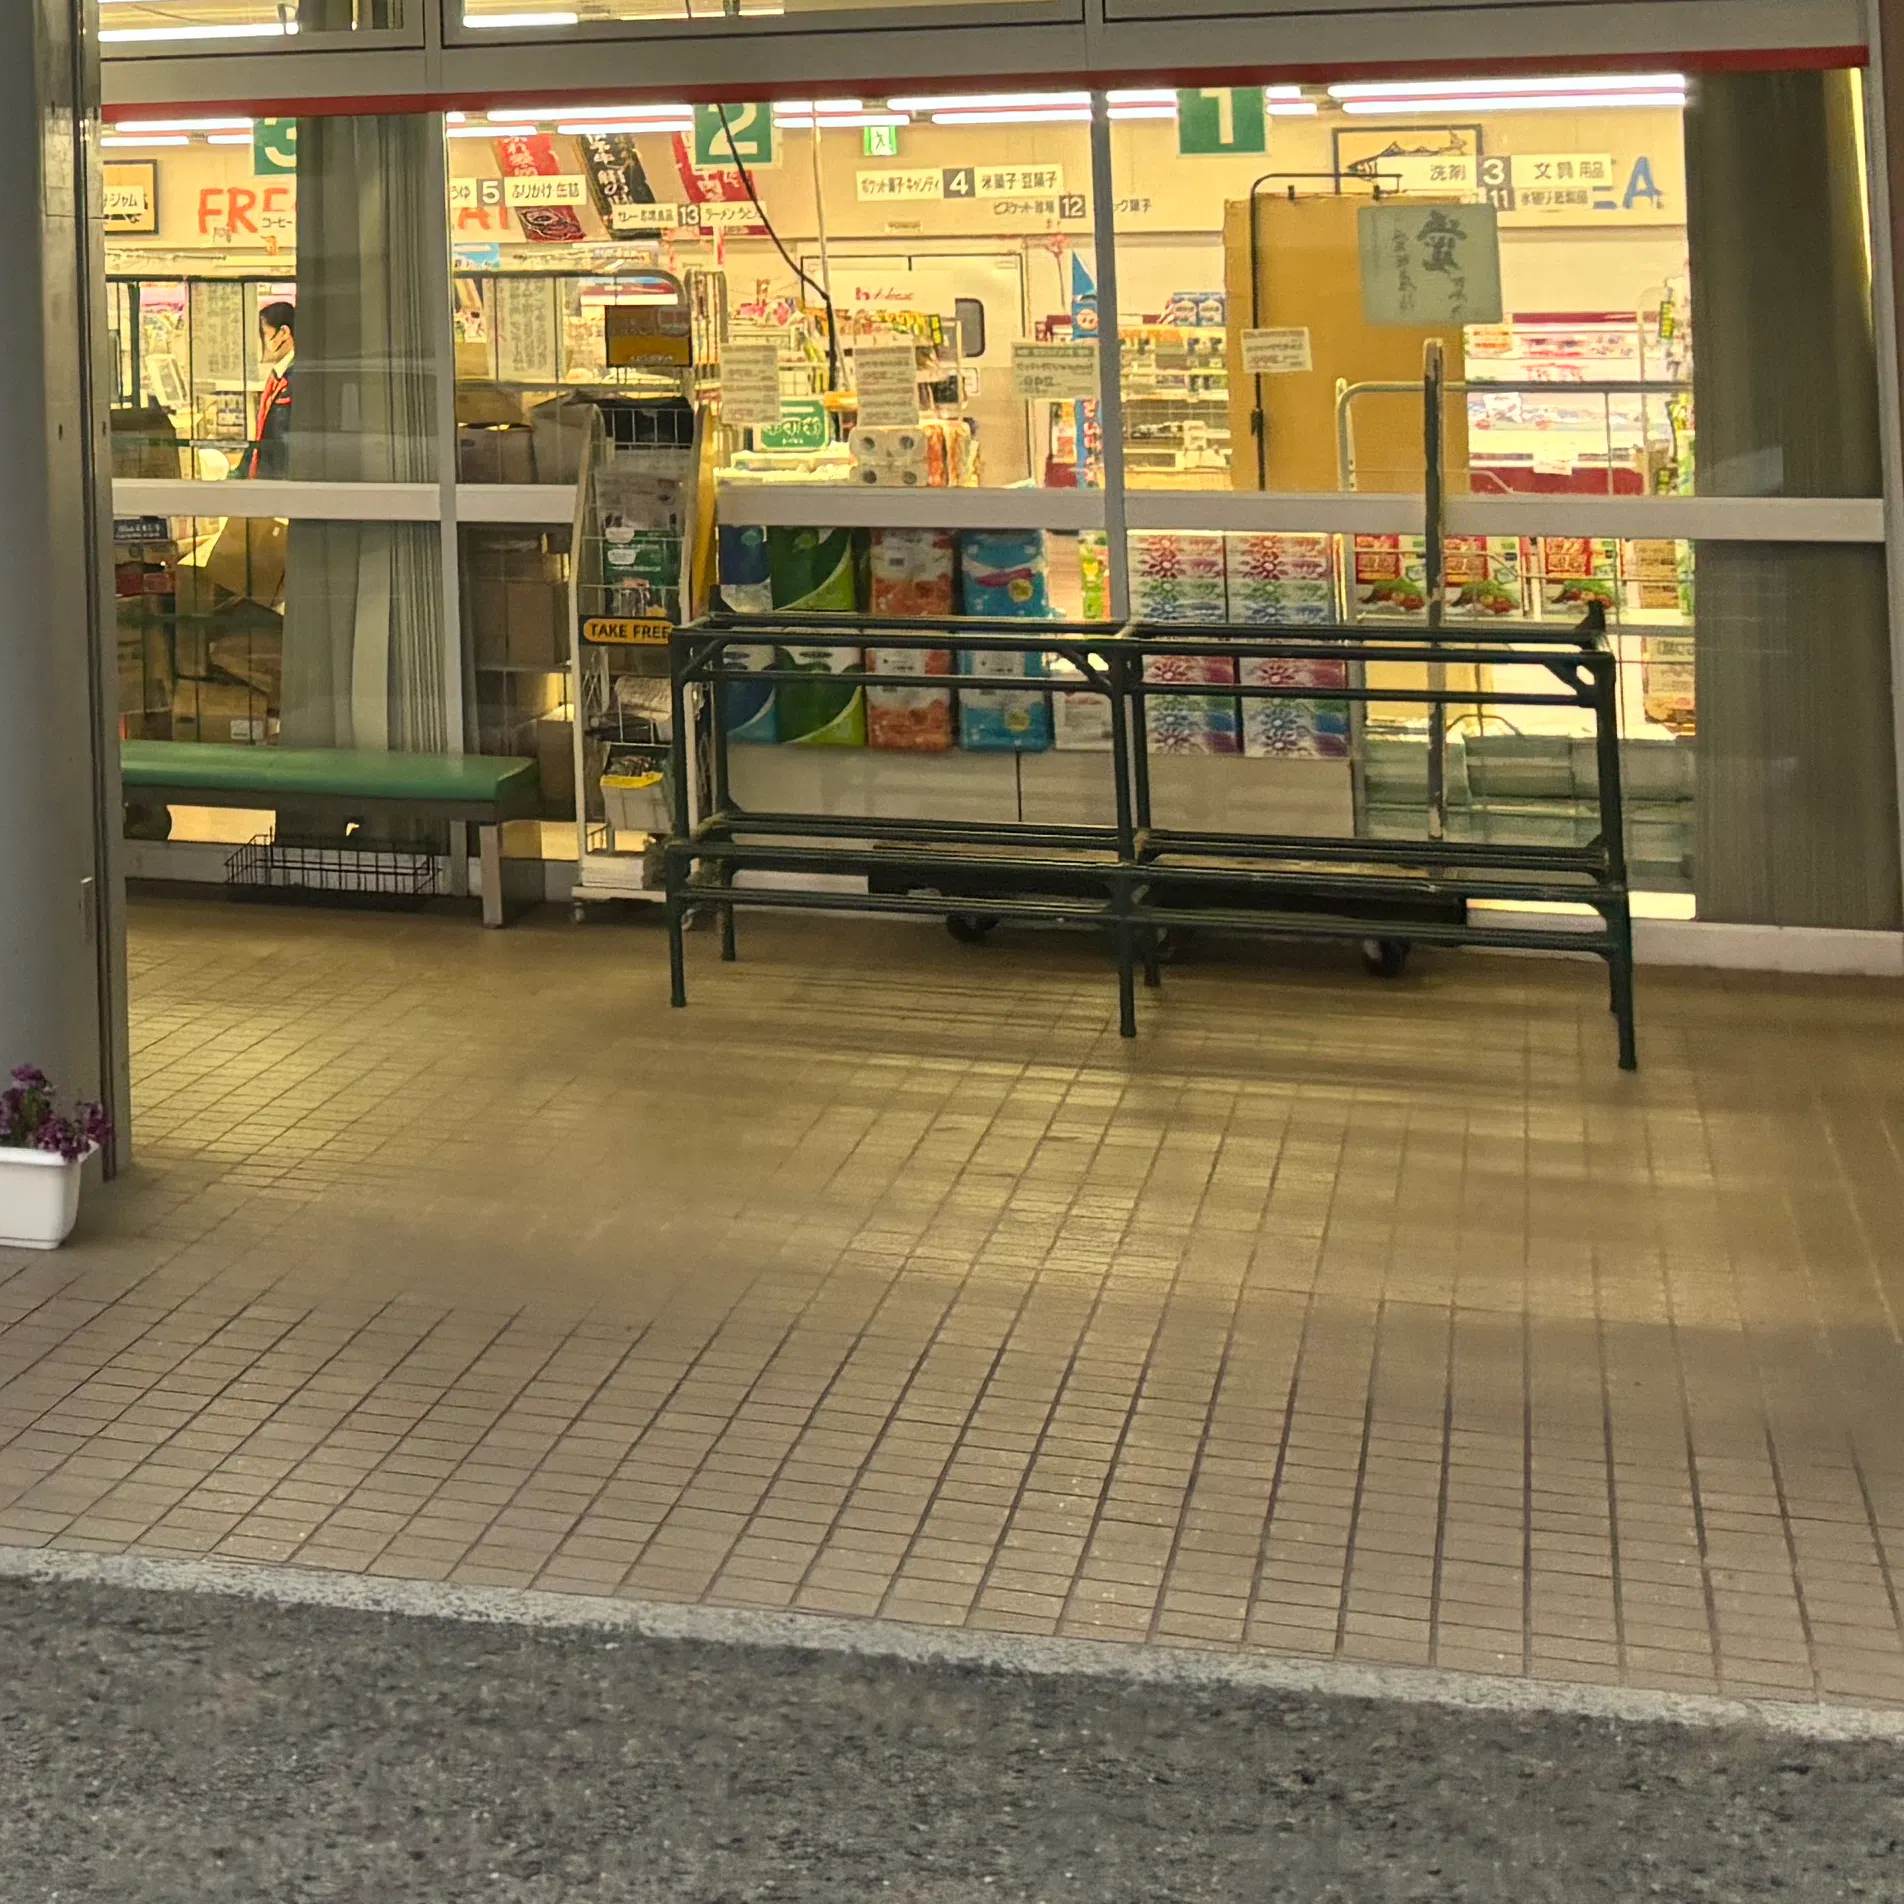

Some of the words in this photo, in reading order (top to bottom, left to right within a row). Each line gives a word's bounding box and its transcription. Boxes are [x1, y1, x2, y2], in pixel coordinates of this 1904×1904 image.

[709, 104, 758, 156] 2
[949, 170, 969, 195] 4
[1483, 159, 1505, 185] 3
[482, 181, 500, 204] 5
[679, 205, 700, 225] 13
[1062, 198, 1085, 216] 12
[590, 622, 628, 638] TAKE
[633, 624, 673, 639] FREE
